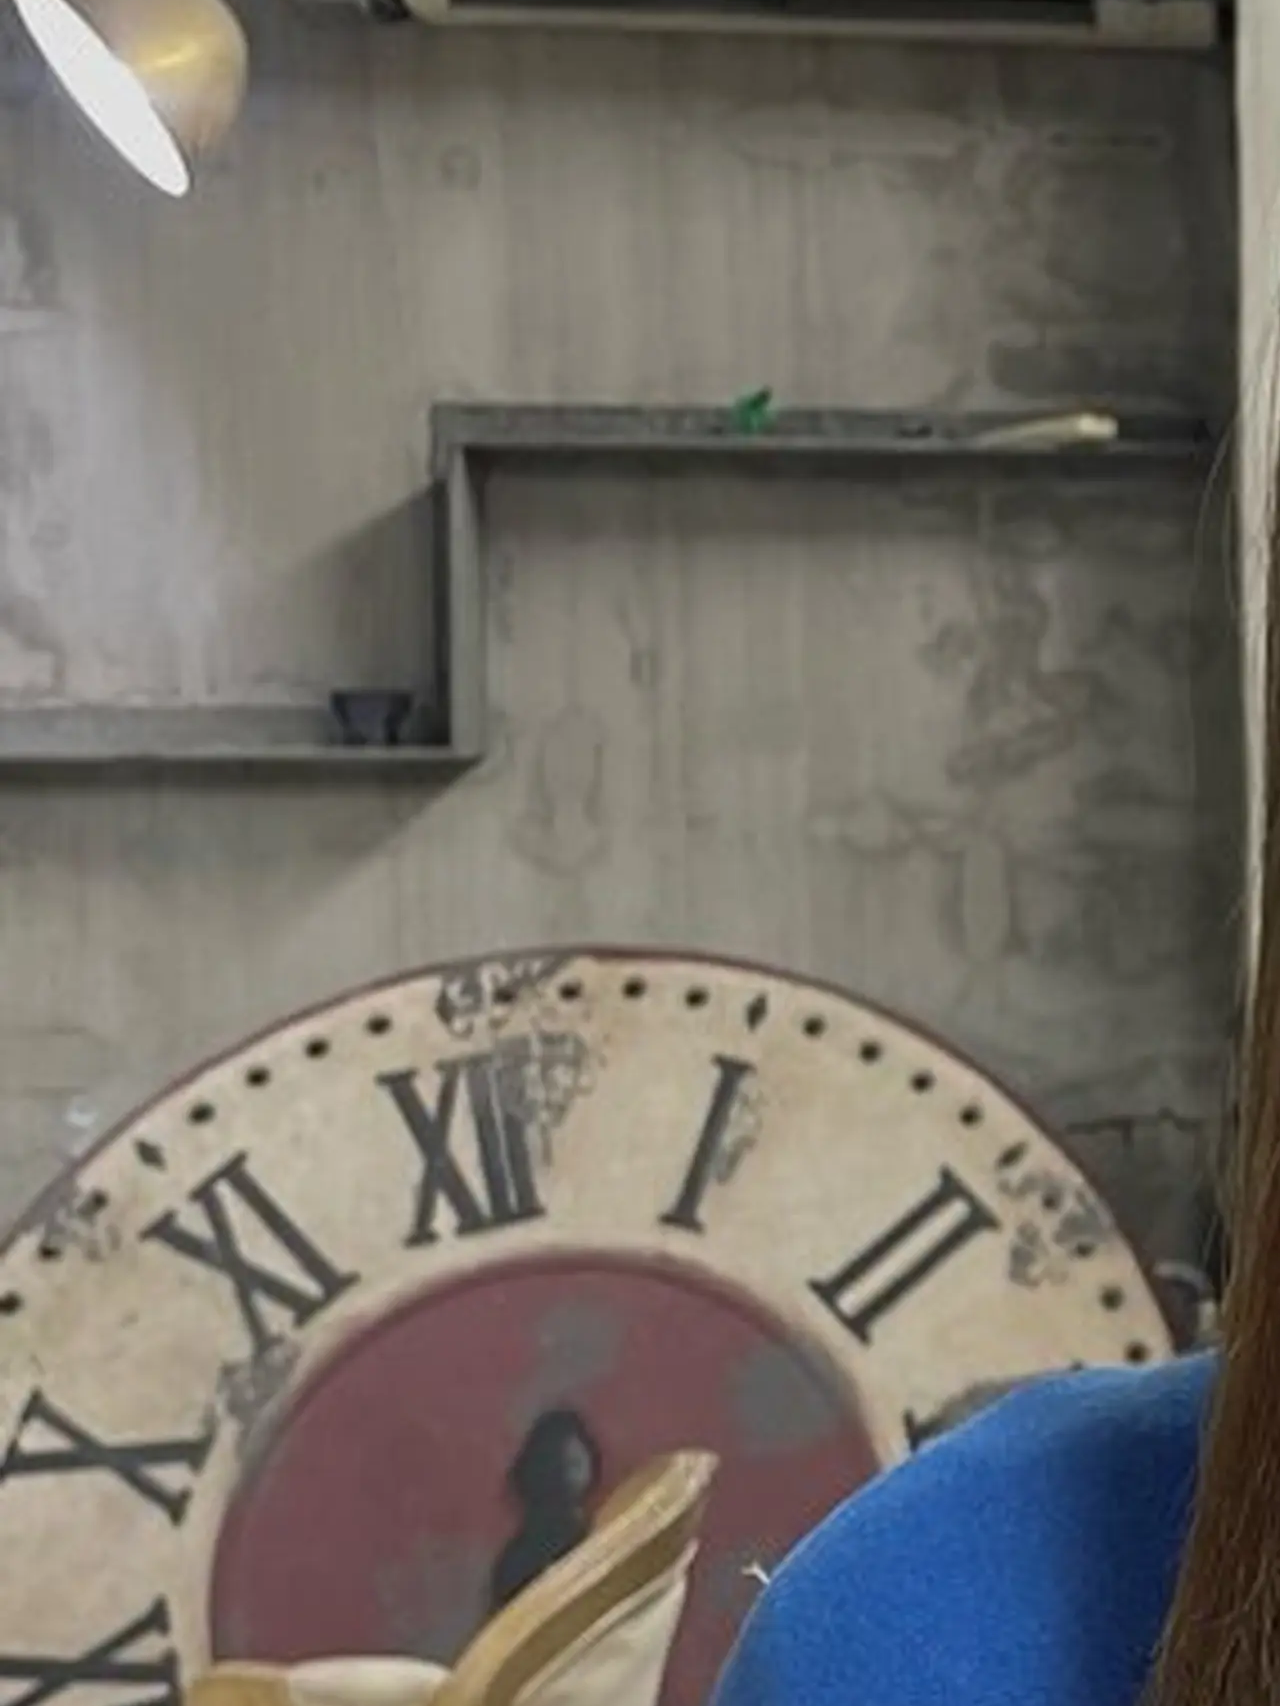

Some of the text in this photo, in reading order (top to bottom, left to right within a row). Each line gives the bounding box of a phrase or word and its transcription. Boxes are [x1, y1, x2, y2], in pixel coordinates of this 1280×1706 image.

[139, 1151, 361, 1345] XI
[807, 1165, 1000, 1344] II
[0, 1388, 216, 1527] X
